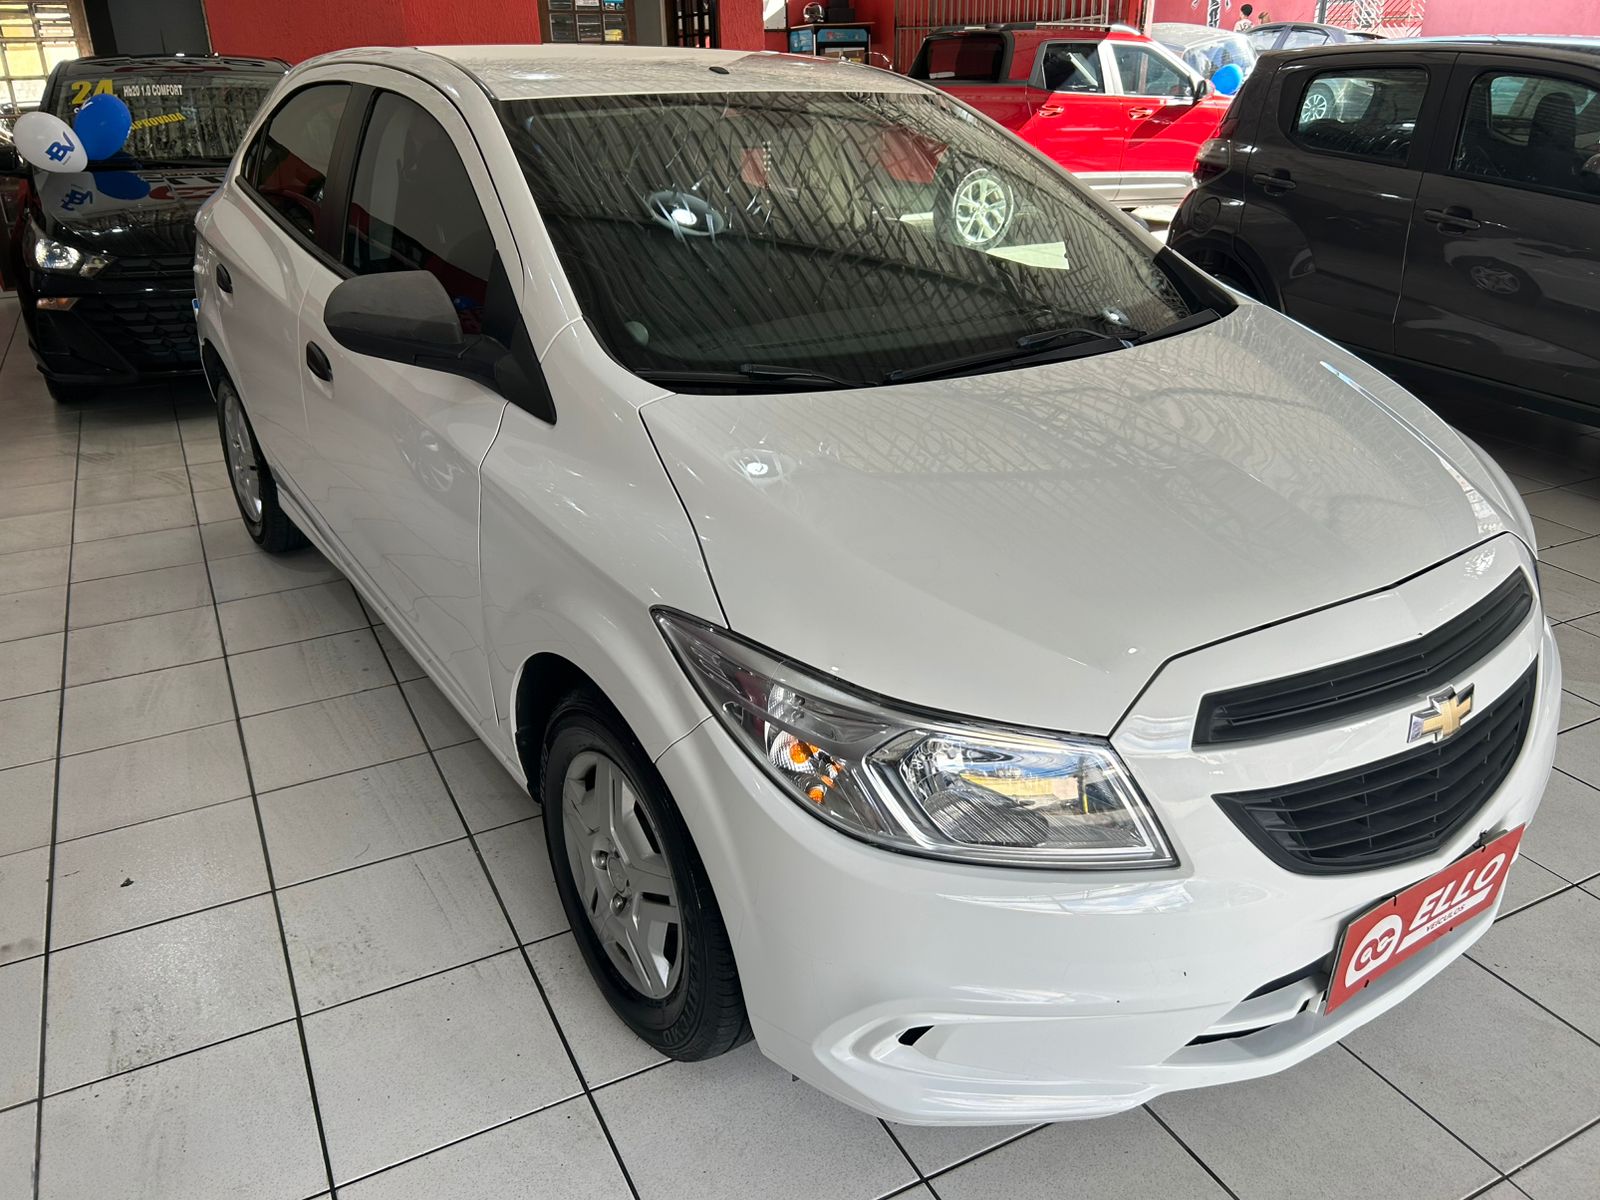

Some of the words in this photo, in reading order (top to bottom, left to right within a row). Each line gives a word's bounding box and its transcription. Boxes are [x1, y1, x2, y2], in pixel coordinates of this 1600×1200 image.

[141, 84, 151, 97] 1.0
[152, 84, 183, 97] COMFORT
[1408, 852, 1506, 931] ELLO
